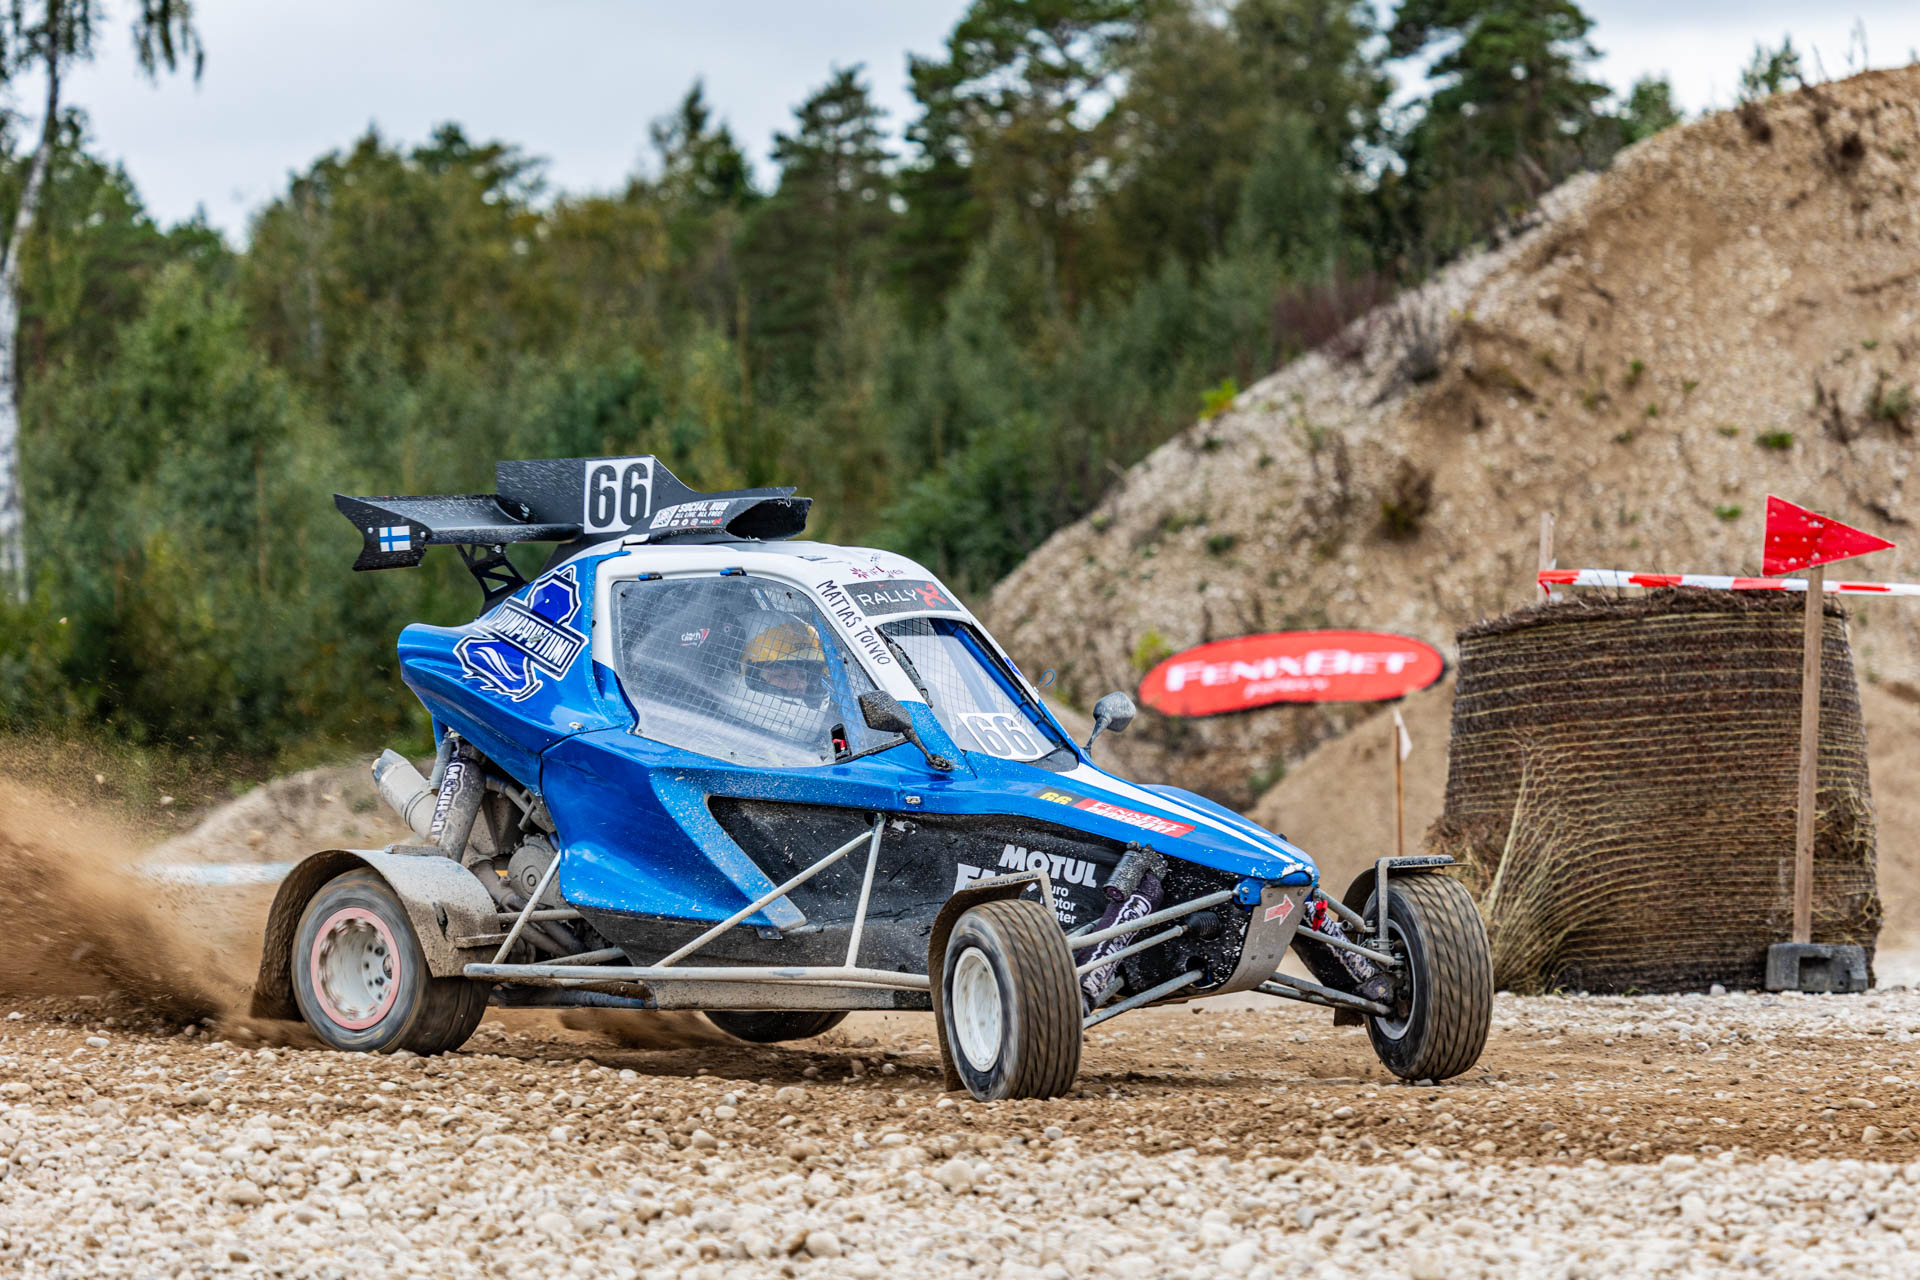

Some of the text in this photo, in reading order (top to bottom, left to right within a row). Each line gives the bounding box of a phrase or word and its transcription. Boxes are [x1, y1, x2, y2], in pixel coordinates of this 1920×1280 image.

[589, 463, 649, 528] 66
[816, 580, 862, 628] MATIAS
[854, 625, 891, 665] TOIVIO
[967, 716, 1038, 757] 66
[1040, 791, 1073, 805] 66
[998, 844, 1097, 888] MOTUL
